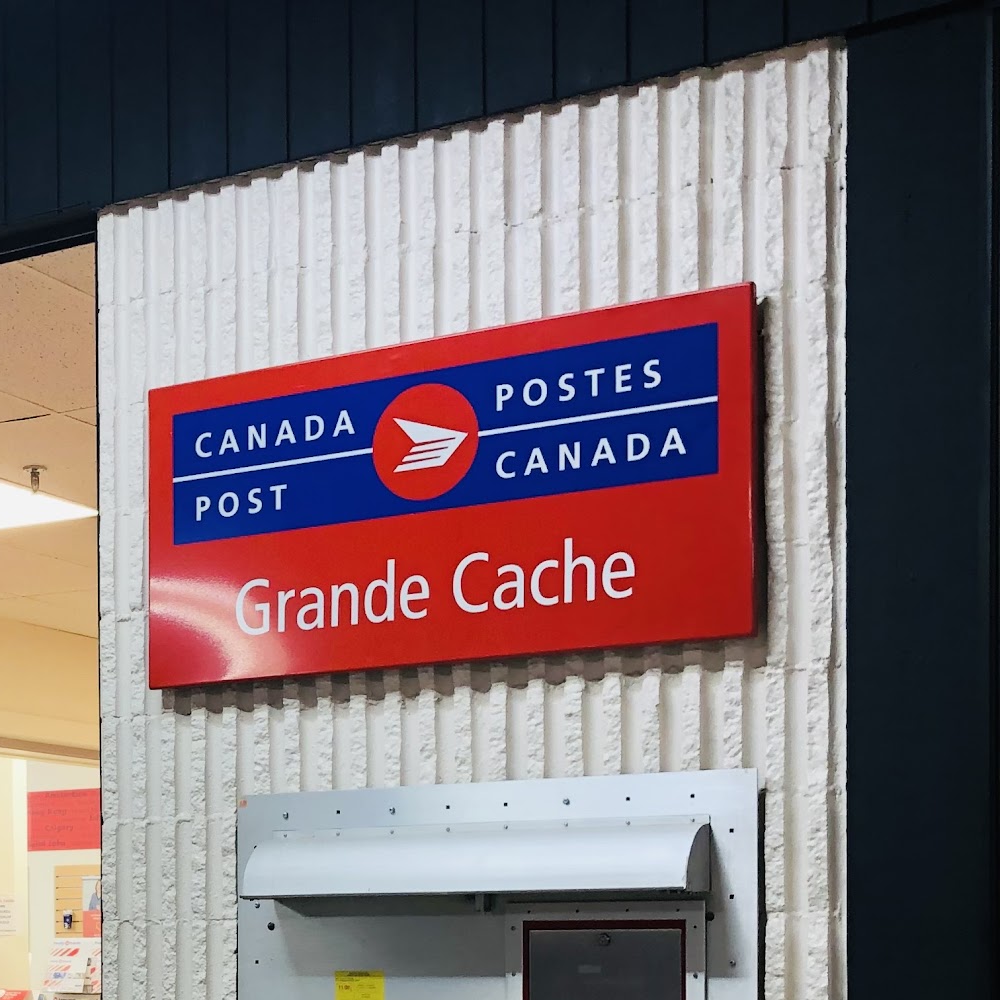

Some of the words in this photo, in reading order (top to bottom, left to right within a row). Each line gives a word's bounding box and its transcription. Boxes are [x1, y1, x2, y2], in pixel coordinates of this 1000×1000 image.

[495, 358, 663, 412] POSTES
[195, 409, 356, 458] CANADA
[495, 427, 687, 480] CANADA
[195, 483, 288, 521] POST
[235, 557, 430, 637] Grande
[452, 537, 637, 614] Cache
